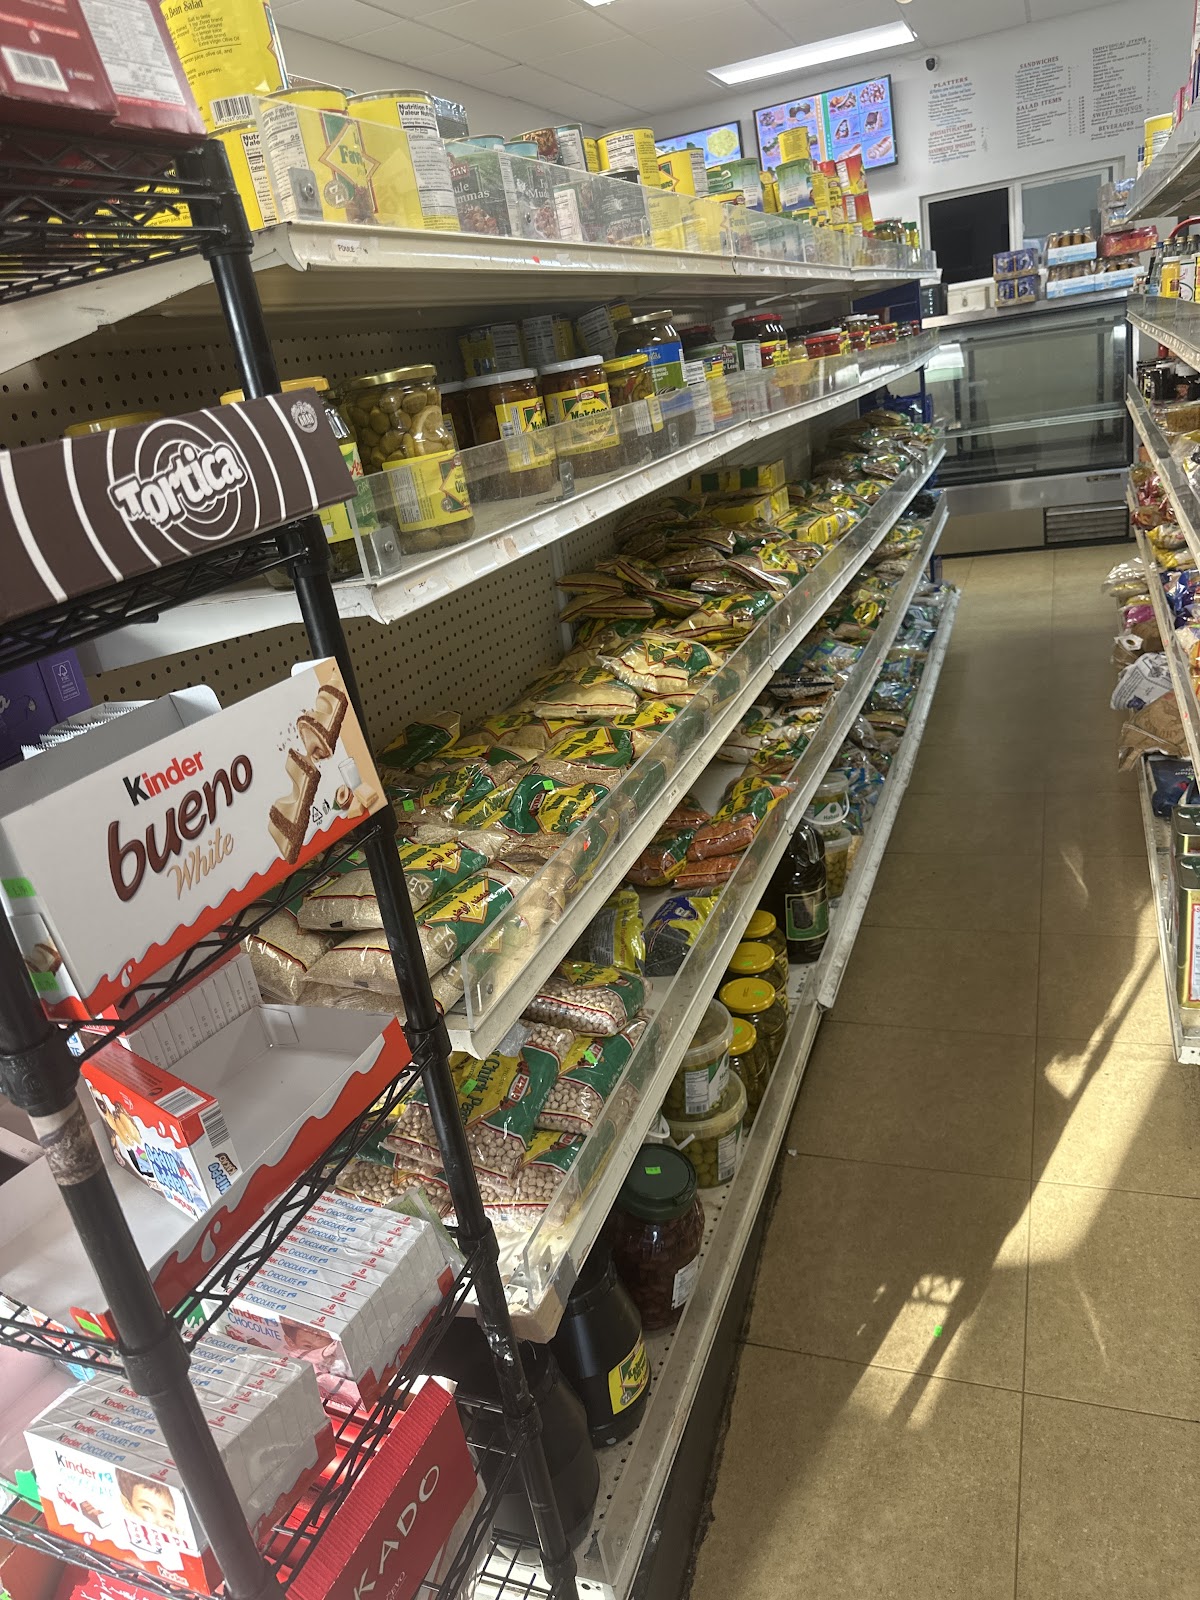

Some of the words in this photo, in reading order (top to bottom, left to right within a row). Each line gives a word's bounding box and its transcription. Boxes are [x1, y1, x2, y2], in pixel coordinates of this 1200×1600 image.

[168, 5, 182, 17] Bean
[1019, 56, 1059, 70] SANDWICHES
[933, 76, 968, 89] PLATTERS
[398, 103, 425, 111] Nutrition
[1016, 102, 1039, 112] SALAD
[1041, 96, 1062, 107] ITEMS
[1092, 110, 1113, 119] SWEET
[1115, 104, 1143, 115] ENDINGS
[1098, 120, 1135, 132] BEVERAGES
[114, 442, 243, 523] Tortica
[122, 751, 205, 807] Kinder
[107, 754, 253, 903] bueno
[166, 827, 235, 900] White
[335, 1198, 365, 1213] CHOCOLATE
[325, 1207, 357, 1222] CHOCOLATE
[316, 1217, 347, 1233] CHOCOLATE
[307, 1227, 338, 1242] CHOCOLATE
[298, 1237, 330, 1252] CHOCOLATE
[288, 1248, 320, 1263] CHOCOLATE
[277, 1258, 309, 1274] CHOCOLATE
[266, 1269, 297, 1285] CHOCOLATE
[256, 1281, 287, 1298] CHOCOLATE
[245, 1293, 277, 1309] CHOCOLATE
[227, 1314, 282, 1341] CHOCOLATE
[204, 1336, 237, 1352] CHOCOLATE
[101, 1396, 128, 1410] Kinder
[86, 1408, 113, 1422] Kinder
[110, 1416, 145, 1433] CHOCOLATE
[71, 1420, 97, 1435] Kinder
[95, 1429, 131, 1446] CHOCOLATE
[56, 1433, 83, 1448] Kinder
[80, 1442, 116, 1460] CHOCOLATE
[55, 1450, 96, 1479] Kinder
